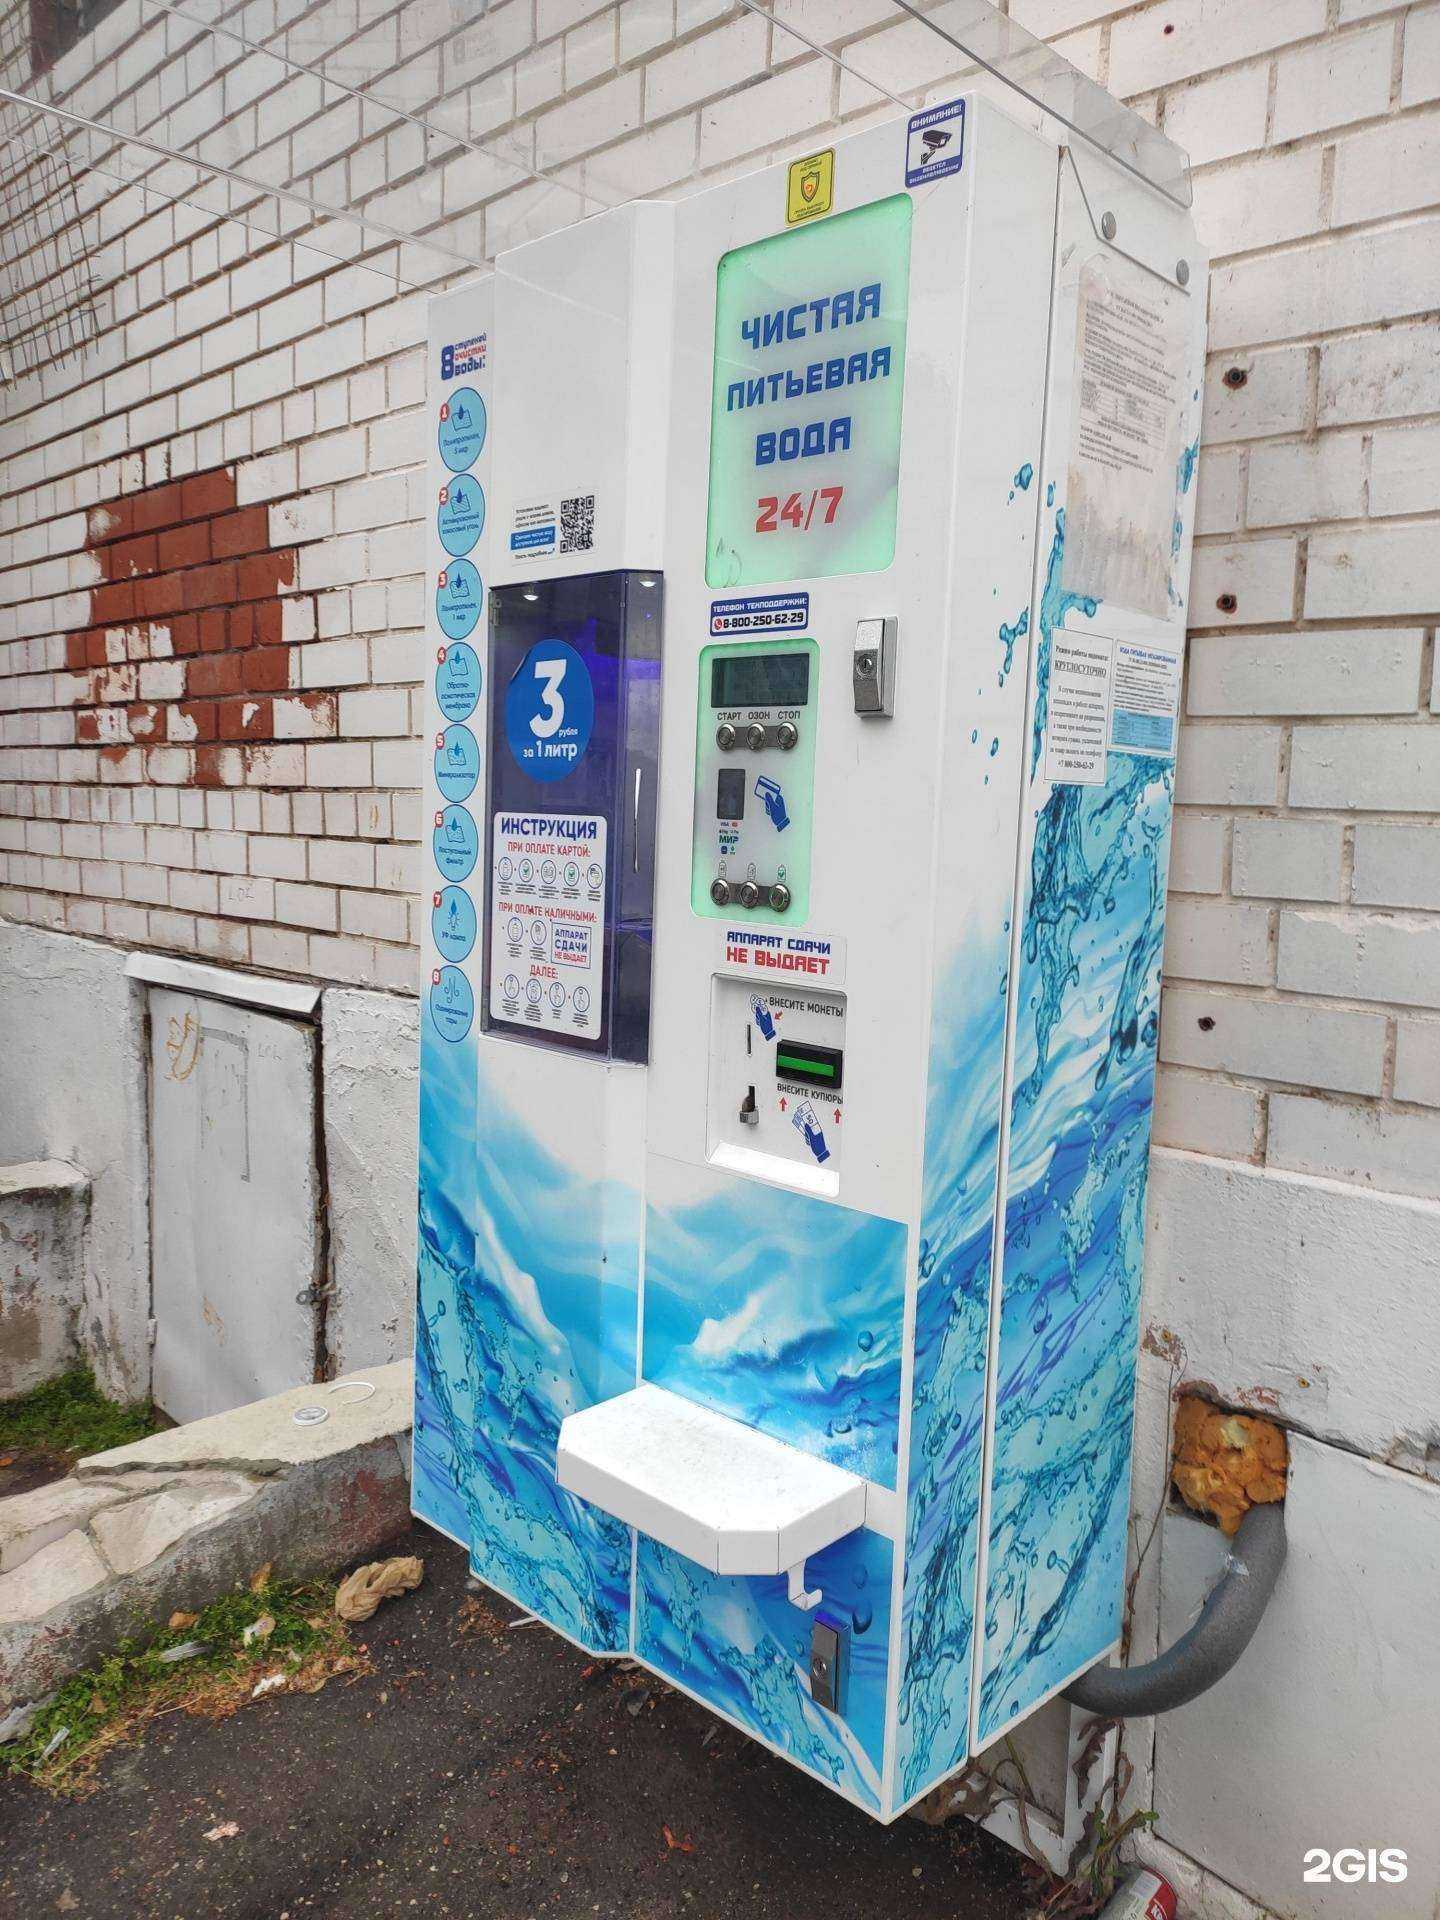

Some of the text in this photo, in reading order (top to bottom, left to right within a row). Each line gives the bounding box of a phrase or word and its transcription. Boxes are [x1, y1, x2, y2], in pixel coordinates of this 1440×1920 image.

[911, 103, 962, 130] ВНИМАНИЕ!
[741, 283, 882, 350] ЧИСТАЯ
[441, 344, 455, 381] 8
[455, 356, 486, 376] воды:
[727, 346, 892, 412] ПИТЬЕВАЯ
[755, 416, 852, 466] ВОДА
[755, 486, 844, 533] 24/7
[713, 602, 745, 613] ТЕЛЕФОН
[723, 611, 804, 629] 8-800-250-62-29
[529, 659, 567, 738] 3
[717, 710, 801, 720] СТАРТ ОЗОН СТОП
[522, 740, 578, 761] за 1 литр
[501, 818, 597, 841] ИНСТРУКЦИЯ
[718, 835, 739, 844] МИР
[507, 842, 591, 857] ПРИ ОПЛАТЕ КАРТОЙ:
[498, 902, 598, 923] ПРИ ОПЛАТЕ НАЛИЧНЫМИ:
[555, 928, 588, 940] АППАРАТ
[727, 931, 831, 955] АППАРАТ СДАЧИ
[554, 939, 588, 953] СДАЧИ
[554, 951, 563, 960] НЕ
[563, 952, 588, 963] ВЫДАЕТ
[726, 946, 830, 975] НЕ ВЫДАЕТ
[529, 964, 559, 979] ДАЛЕЕ:
[769, 996, 844, 1017] ВНЕСИТЕ МОНЕТЫ
[777, 1082, 844, 1105] ВНЕСИТЕ КУПЮРЫ
